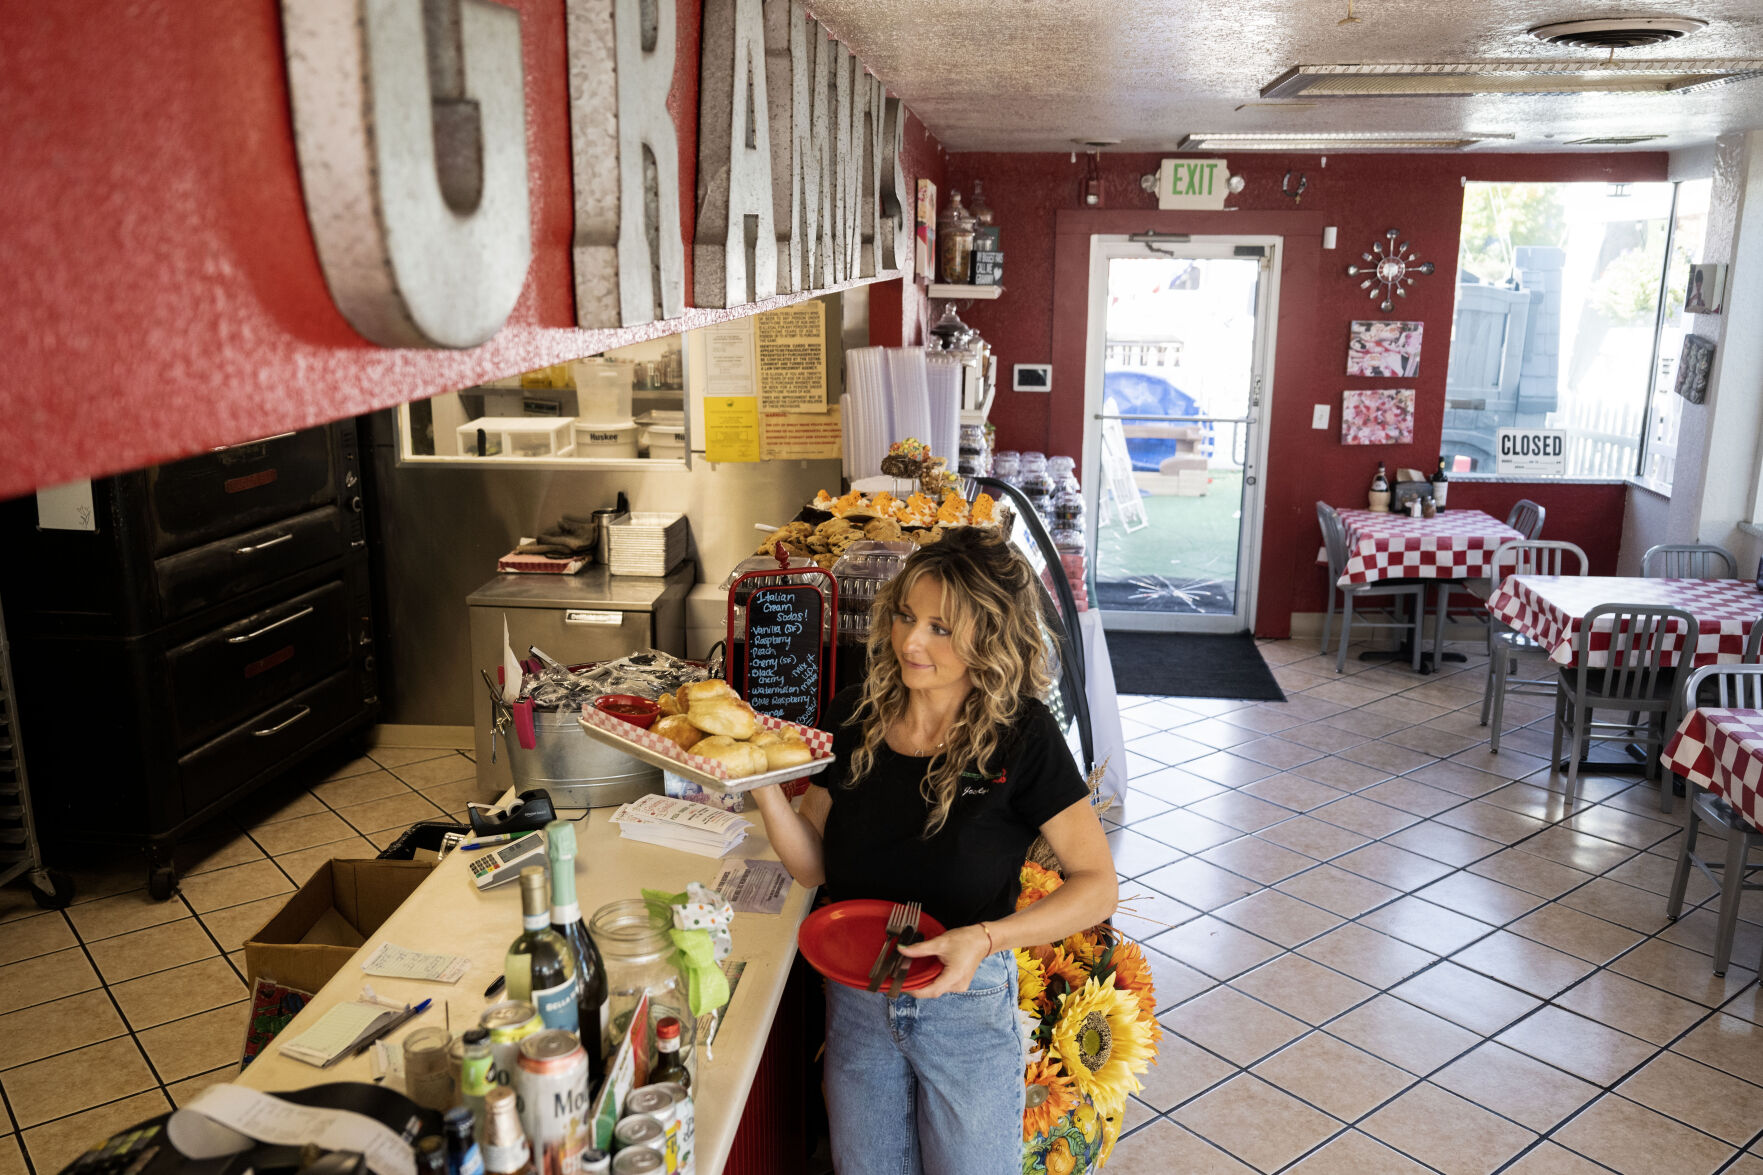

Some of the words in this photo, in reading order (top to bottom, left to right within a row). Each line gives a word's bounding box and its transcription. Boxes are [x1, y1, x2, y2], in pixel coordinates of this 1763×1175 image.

[1172, 163, 1218, 195] EXIT
[976, 263, 987, 274] CALL
[590, 433, 618, 441] Huskee
[1502, 434, 1562, 456] CLOSED
[756, 591, 795, 604] Italian
[763, 603, 793, 612] Cream
[777, 609, 808, 621] Sodas!
[785, 622, 803, 634] (SF)
[754, 636, 791, 651] Raspberry
[752, 647, 776, 658] Peach
[780, 654, 797, 664] (SF)
[752, 697, 770, 707] Blue
[772, 696, 810, 708] Raspberry
